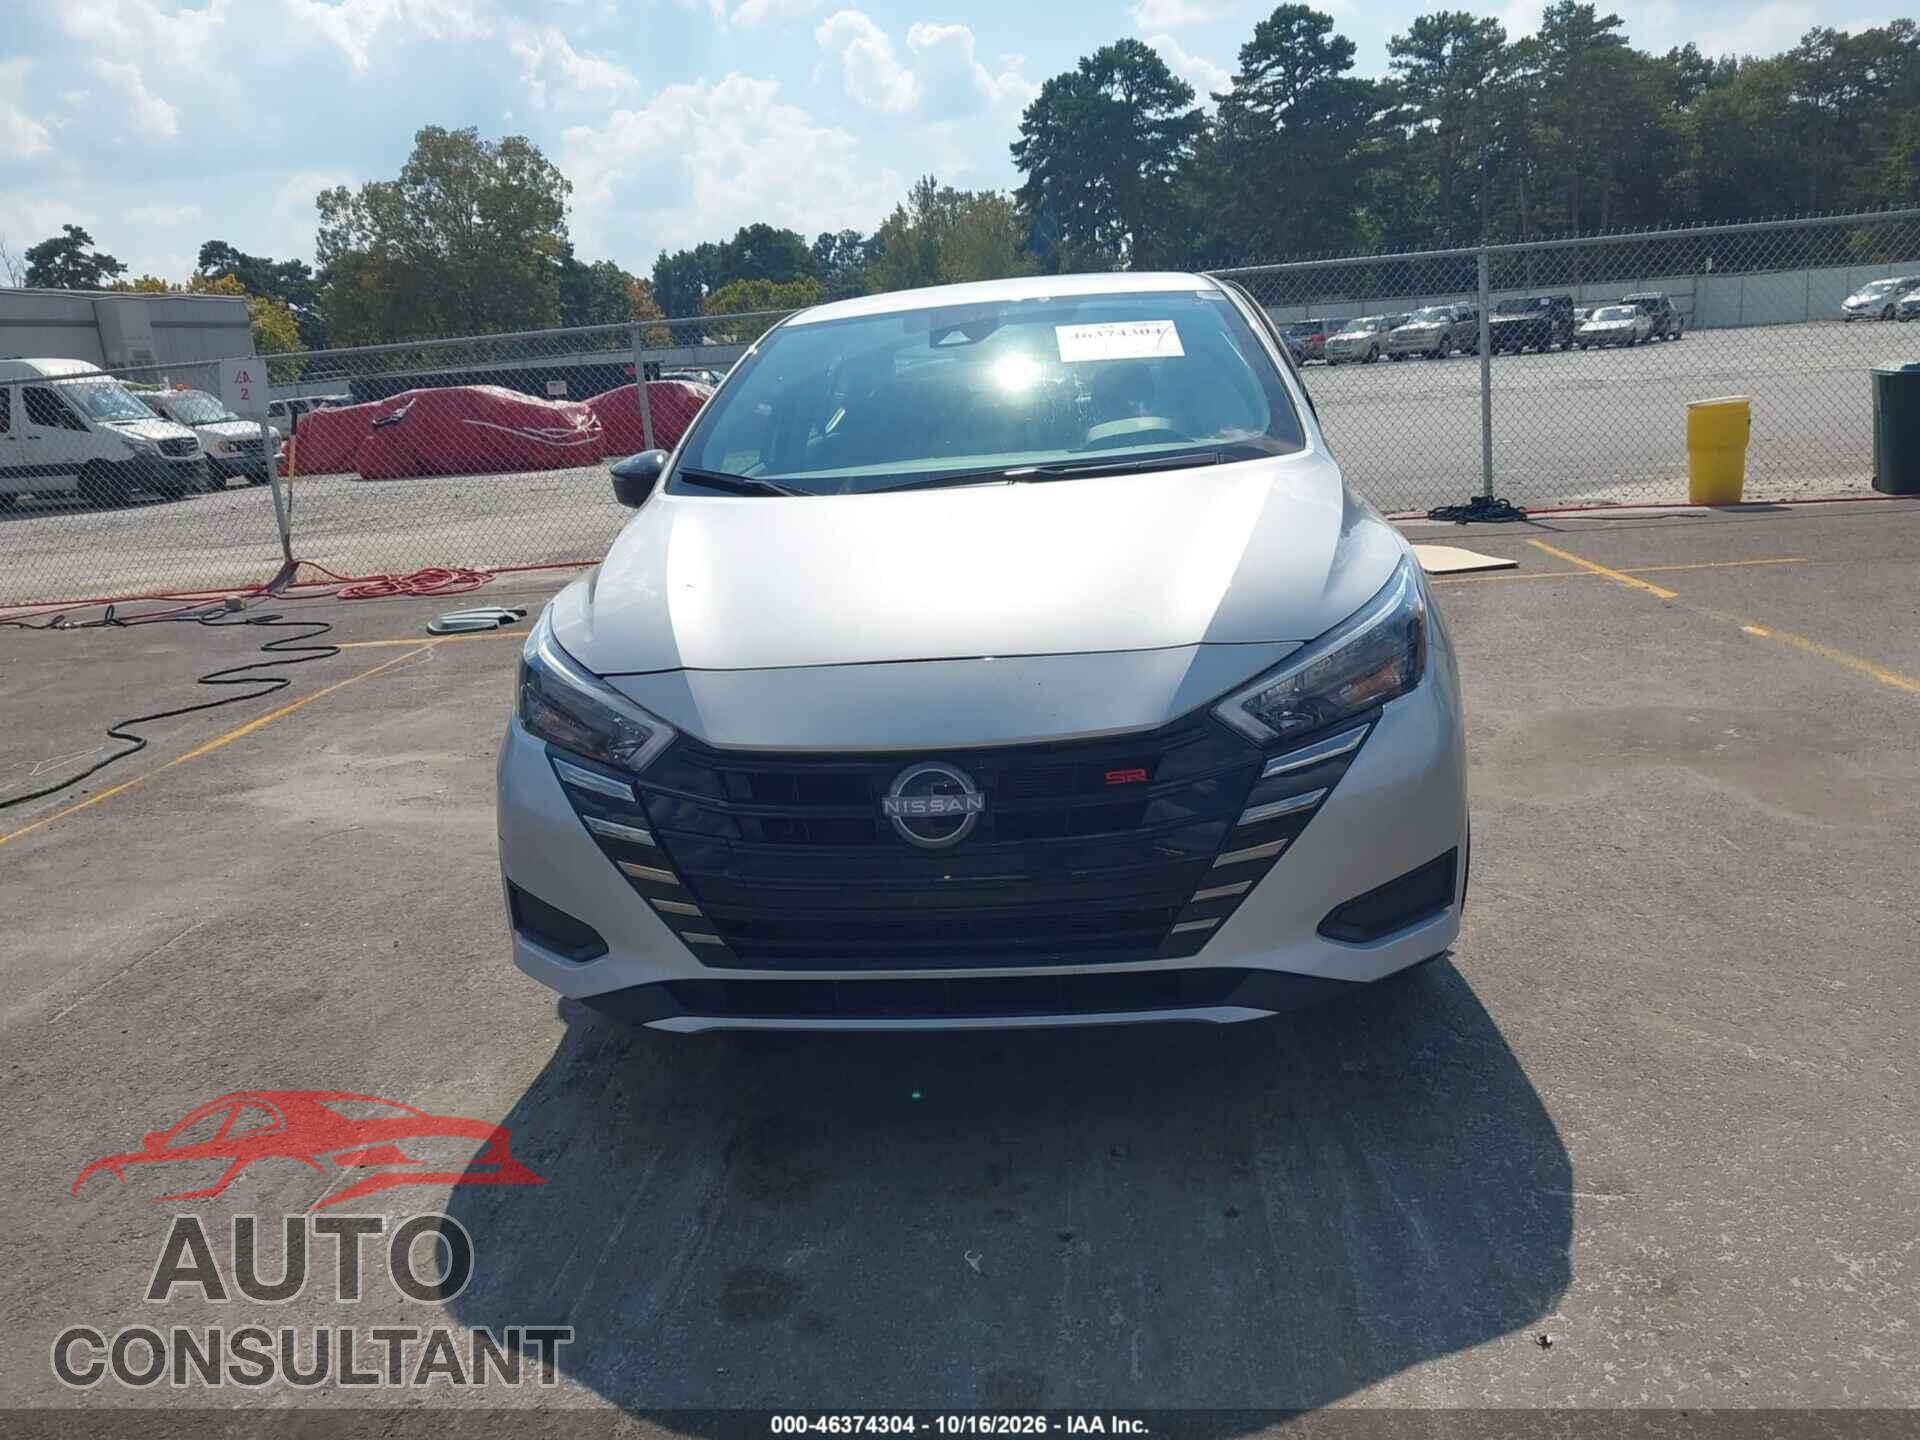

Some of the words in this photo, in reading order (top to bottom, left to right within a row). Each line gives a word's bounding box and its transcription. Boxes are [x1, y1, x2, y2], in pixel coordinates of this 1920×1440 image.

[240, 387, 249, 401] 2
[1105, 768, 1147, 785] SR
[884, 796, 983, 814] NISSAN
